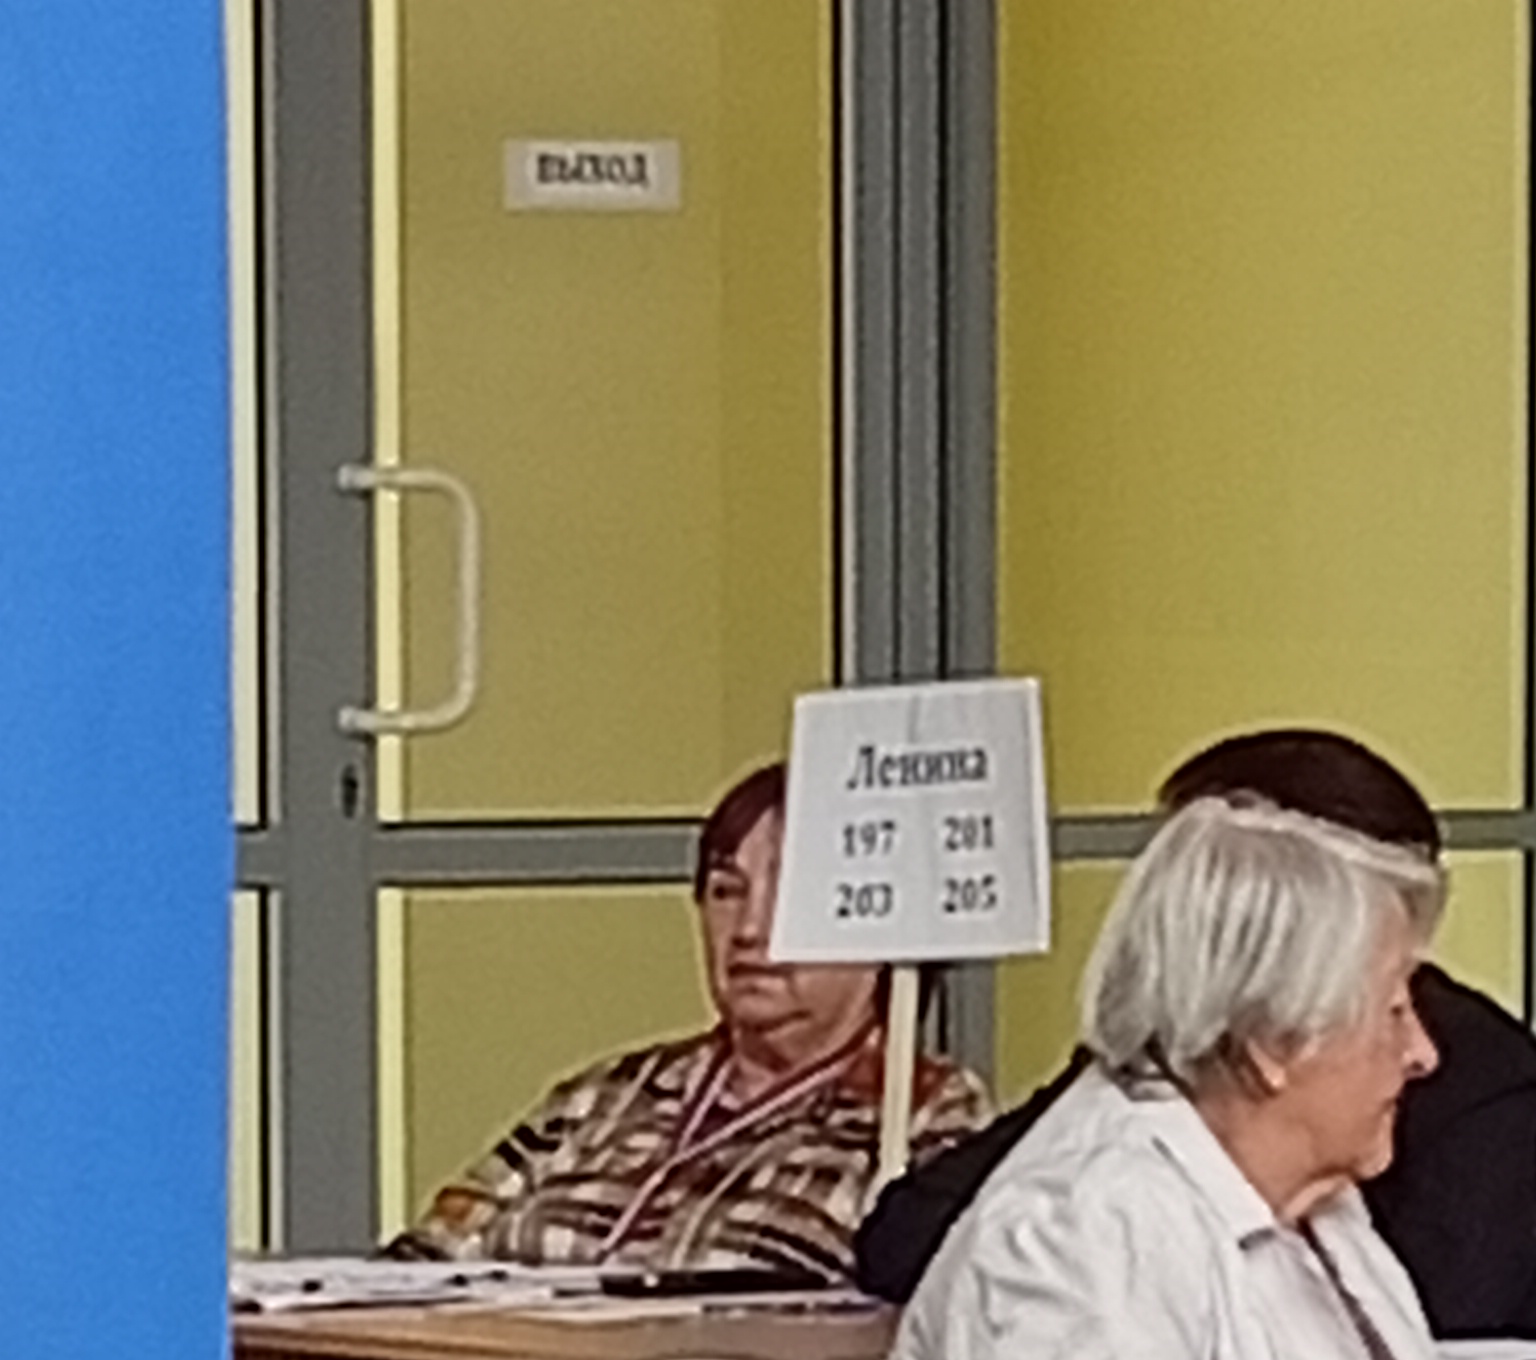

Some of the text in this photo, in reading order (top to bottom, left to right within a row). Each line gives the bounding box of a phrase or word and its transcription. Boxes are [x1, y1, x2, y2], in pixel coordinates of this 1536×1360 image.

[846, 745, 988, 790] Ленина
[841, 814, 995, 858] 197 201
[836, 873, 998, 919] 203 205
